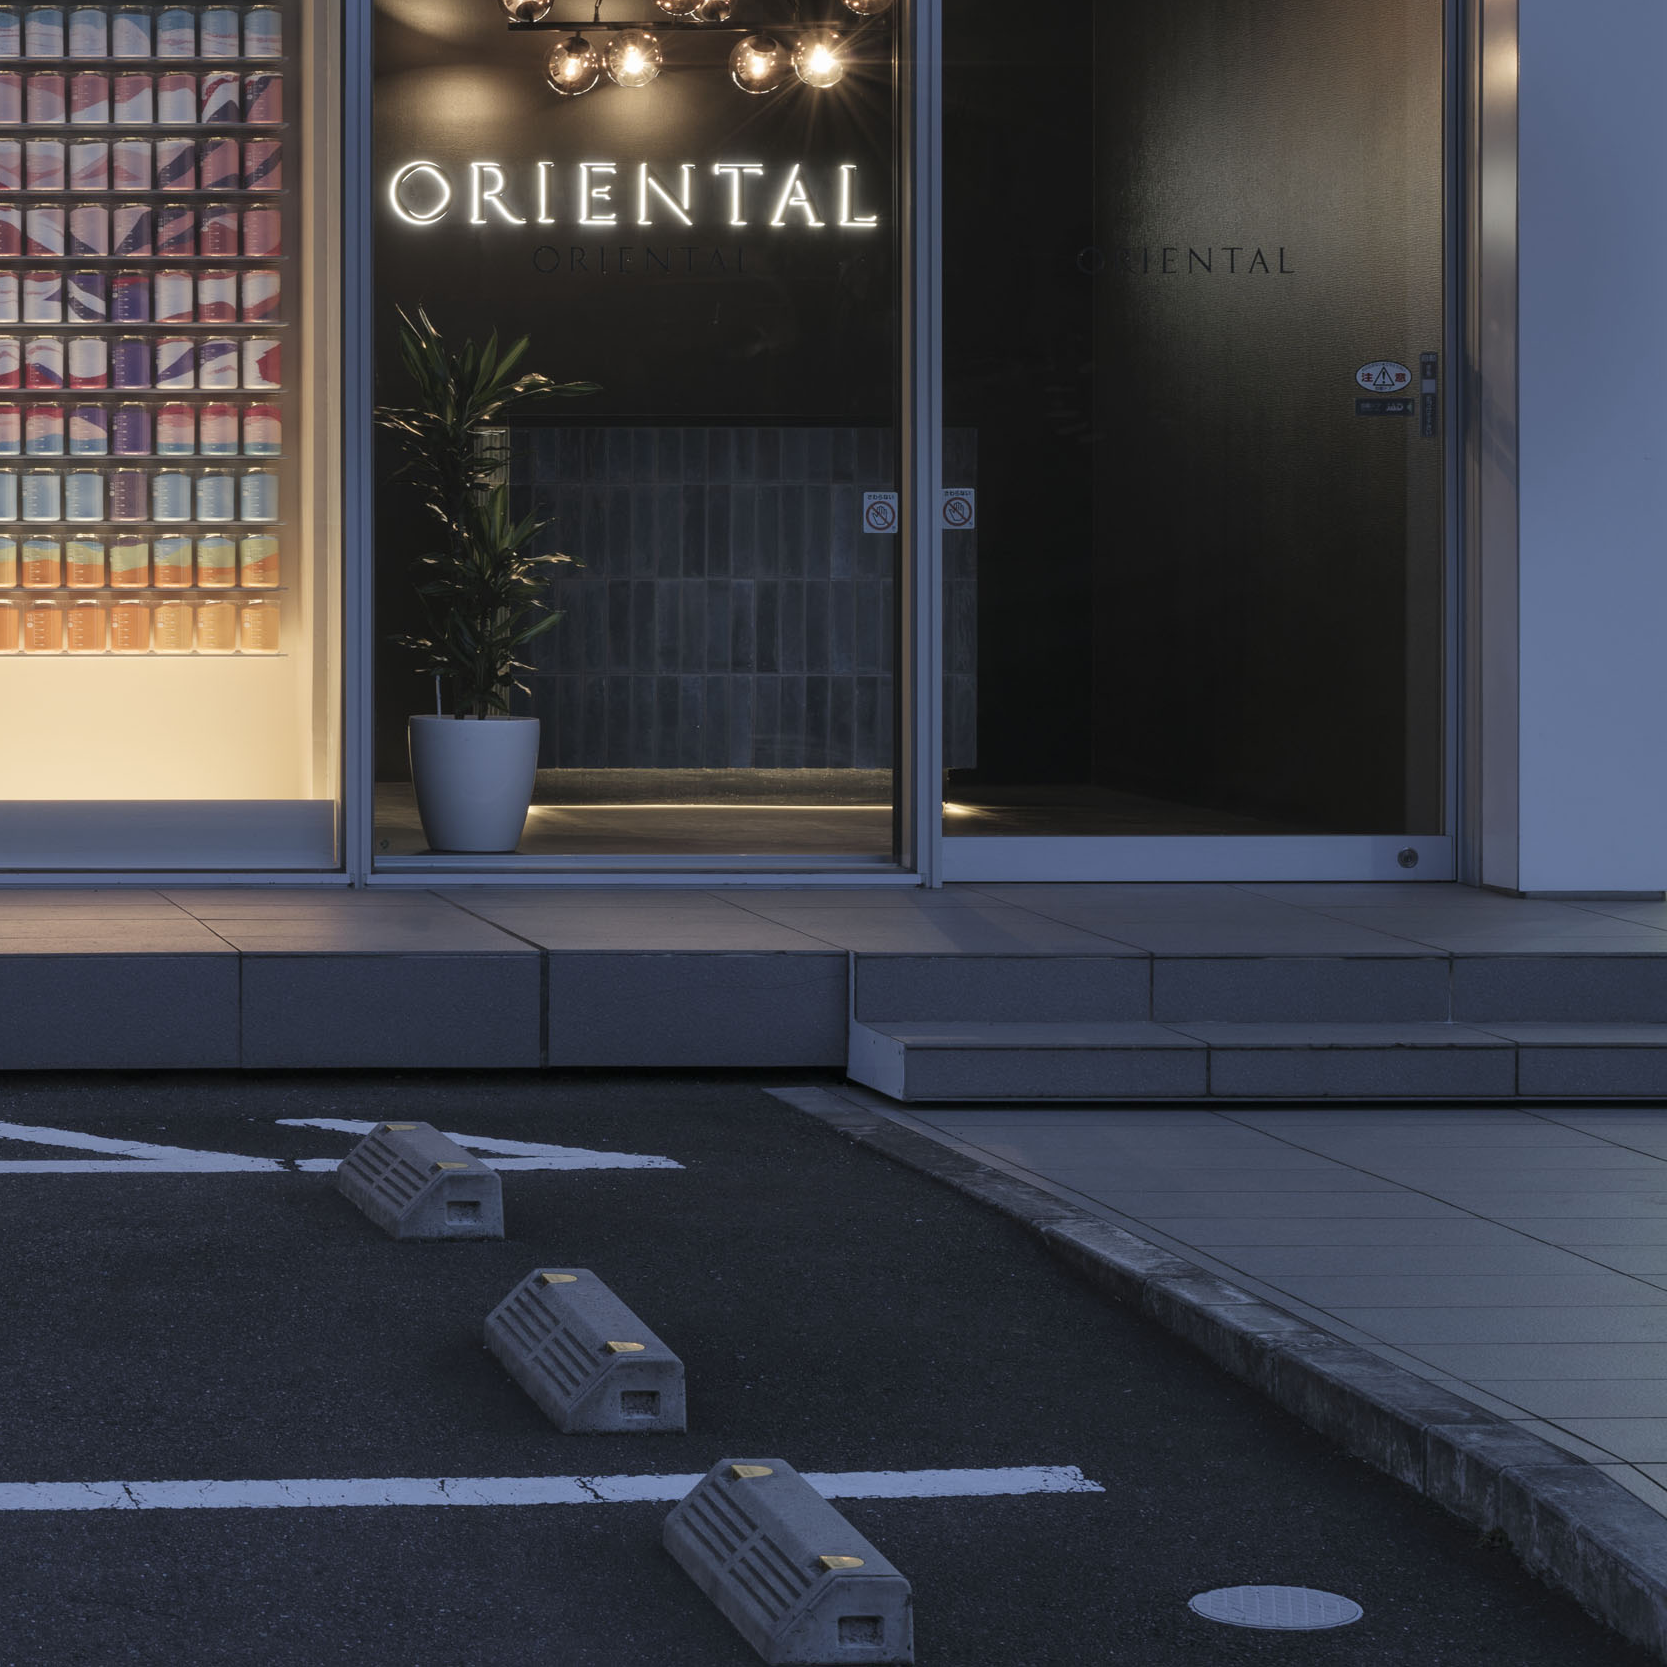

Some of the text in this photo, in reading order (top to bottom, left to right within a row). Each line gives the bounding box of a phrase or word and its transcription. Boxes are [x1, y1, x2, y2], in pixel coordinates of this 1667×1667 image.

[388, 159, 880, 228] ORIENTAL
[533, 244, 750, 274] ORIENTAL
[1075, 245, 1296, 277] ORIENTAL
